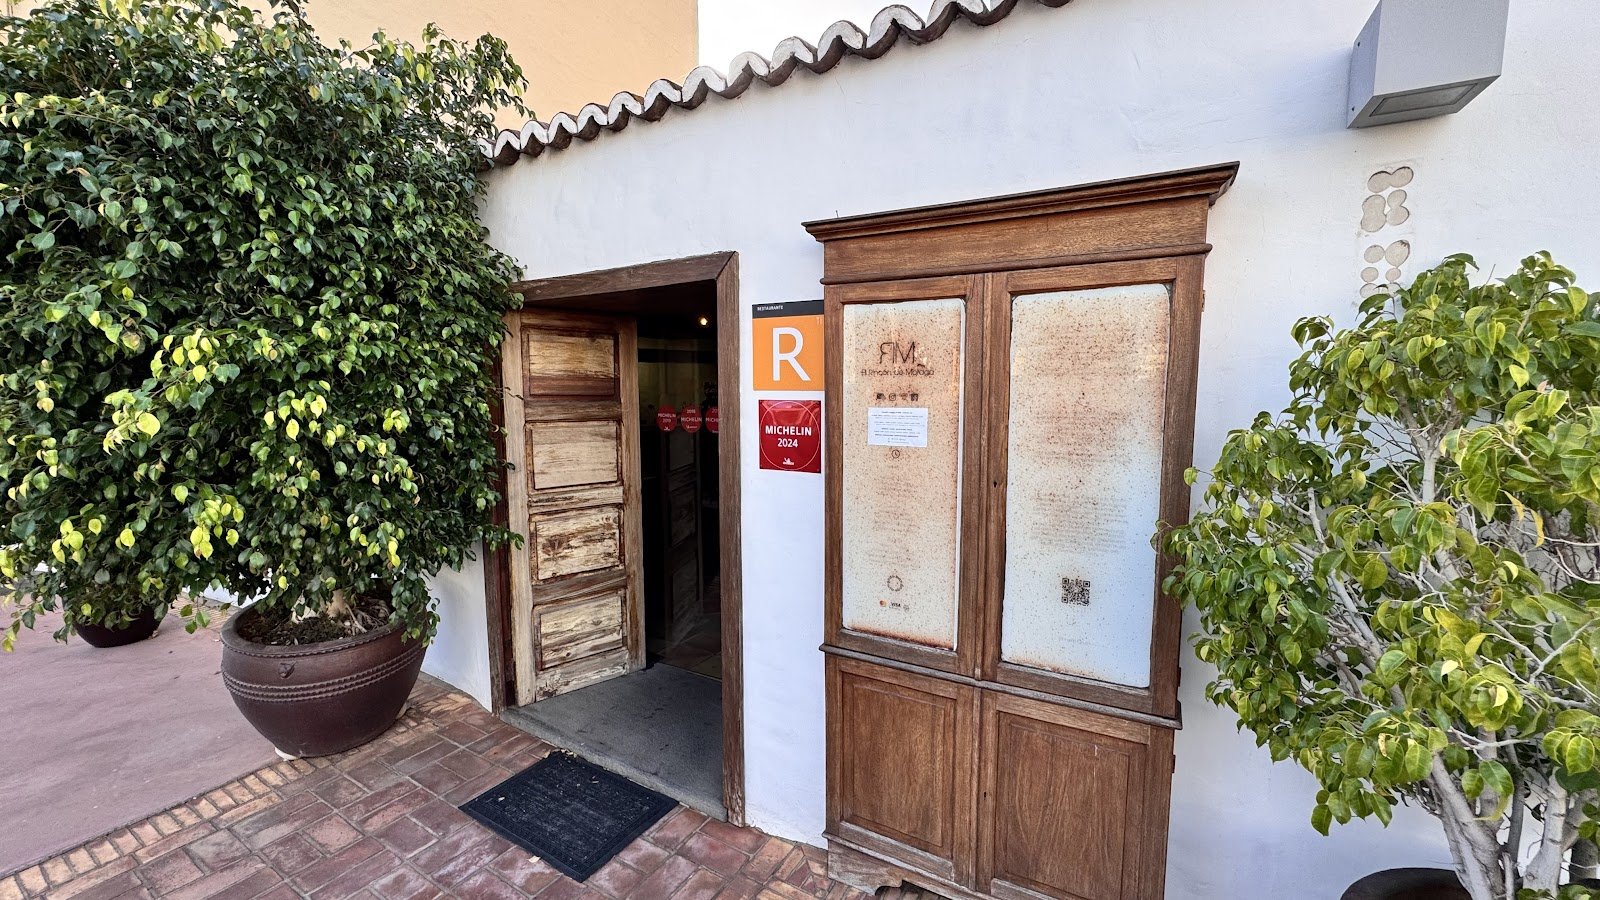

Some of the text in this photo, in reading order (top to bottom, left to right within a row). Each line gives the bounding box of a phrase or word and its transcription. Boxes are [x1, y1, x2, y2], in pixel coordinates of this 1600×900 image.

[772, 327, 811, 382] R
[765, 425, 812, 436] MICHELIN
[777, 438, 799, 448] 2024
